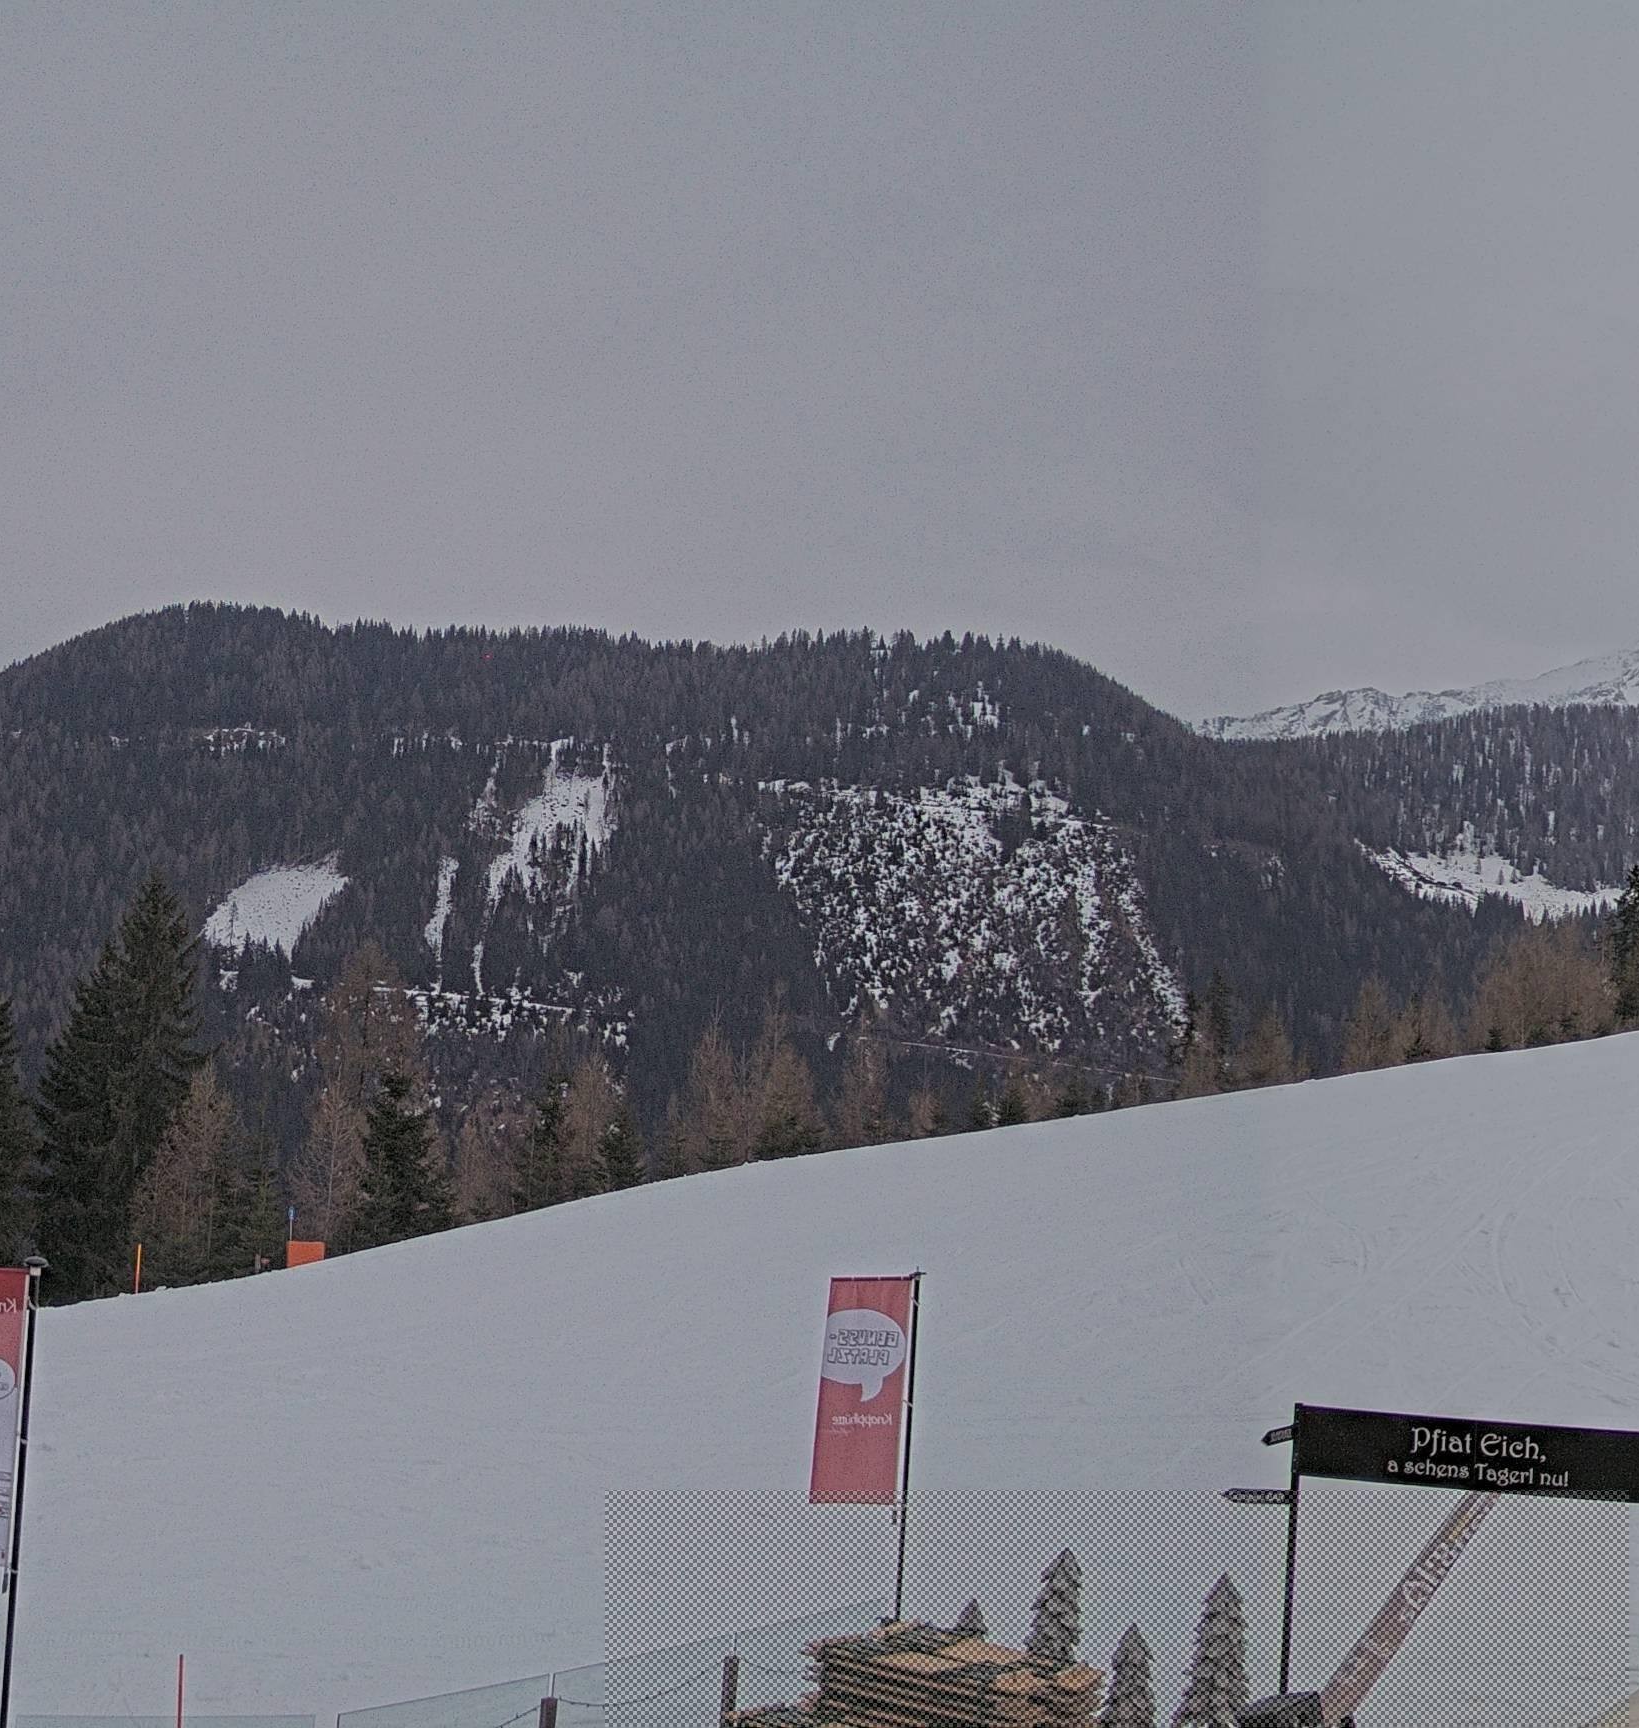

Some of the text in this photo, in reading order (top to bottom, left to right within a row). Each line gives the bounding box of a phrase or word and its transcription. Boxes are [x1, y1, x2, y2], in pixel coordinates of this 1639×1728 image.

[1411, 1426, 1547, 1463] Pfiat Eich,
[1387, 1459, 1569, 1488] a schens Tagerl nu!
